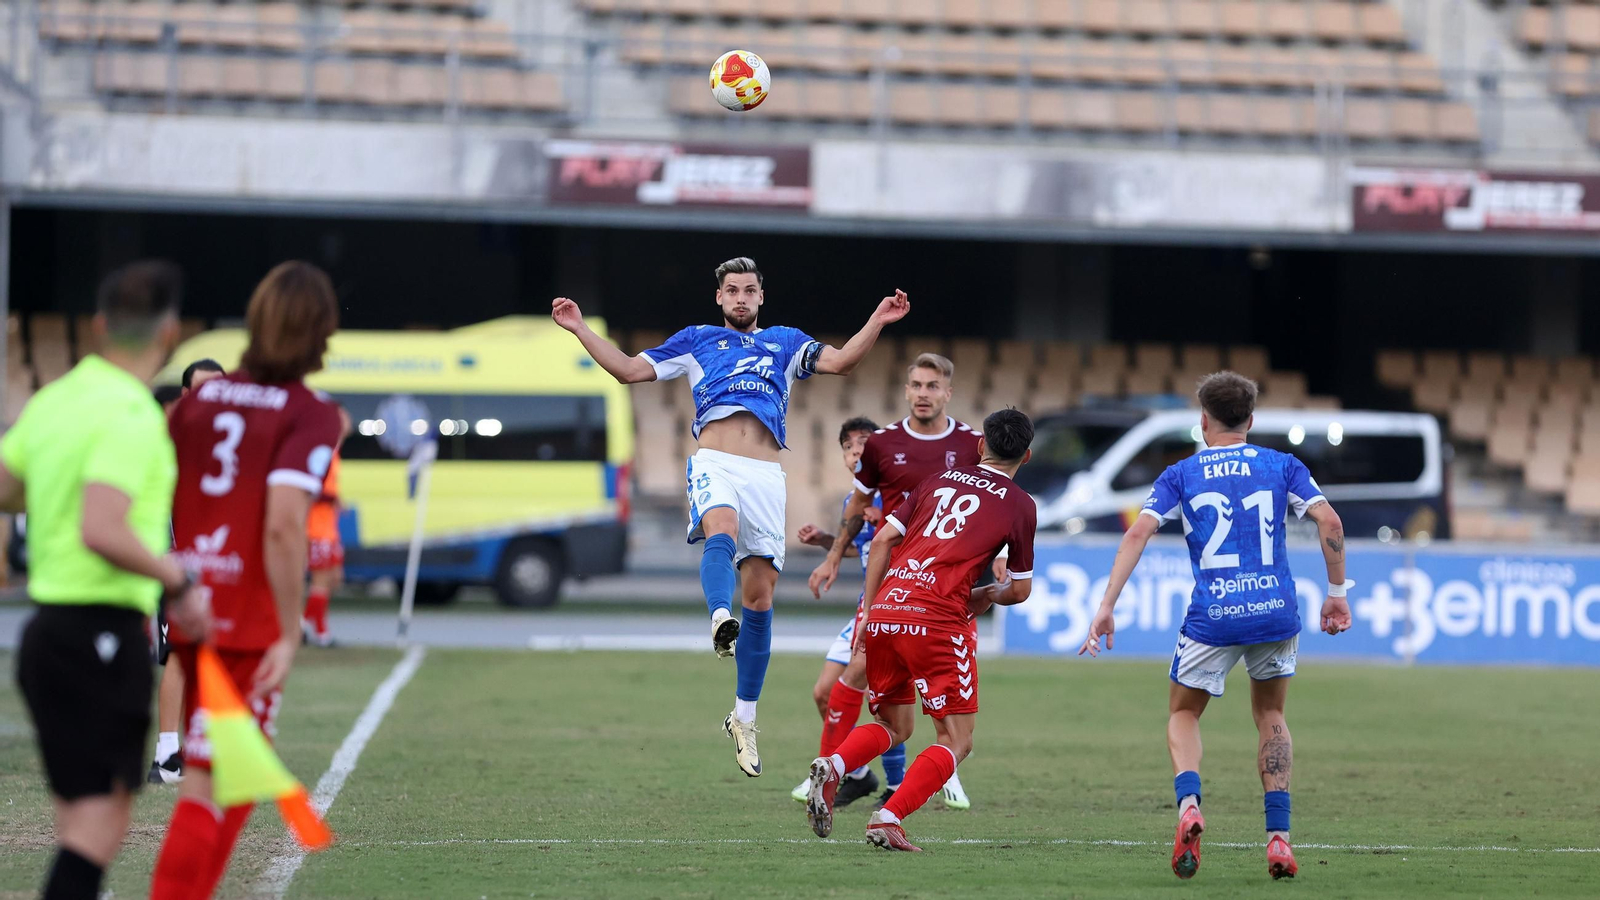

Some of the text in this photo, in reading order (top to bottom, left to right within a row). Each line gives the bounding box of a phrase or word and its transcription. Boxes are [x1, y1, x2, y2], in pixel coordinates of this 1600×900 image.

[200, 410, 247, 496] 3
[939, 470, 1008, 500] ARREOLA
[1203, 460, 1252, 480] EKIZA
[922, 487, 981, 540] 18
[1188, 490, 1275, 570] 21
[1223, 598, 1286, 615] san benito
[1271, 724, 1282, 735] 10
